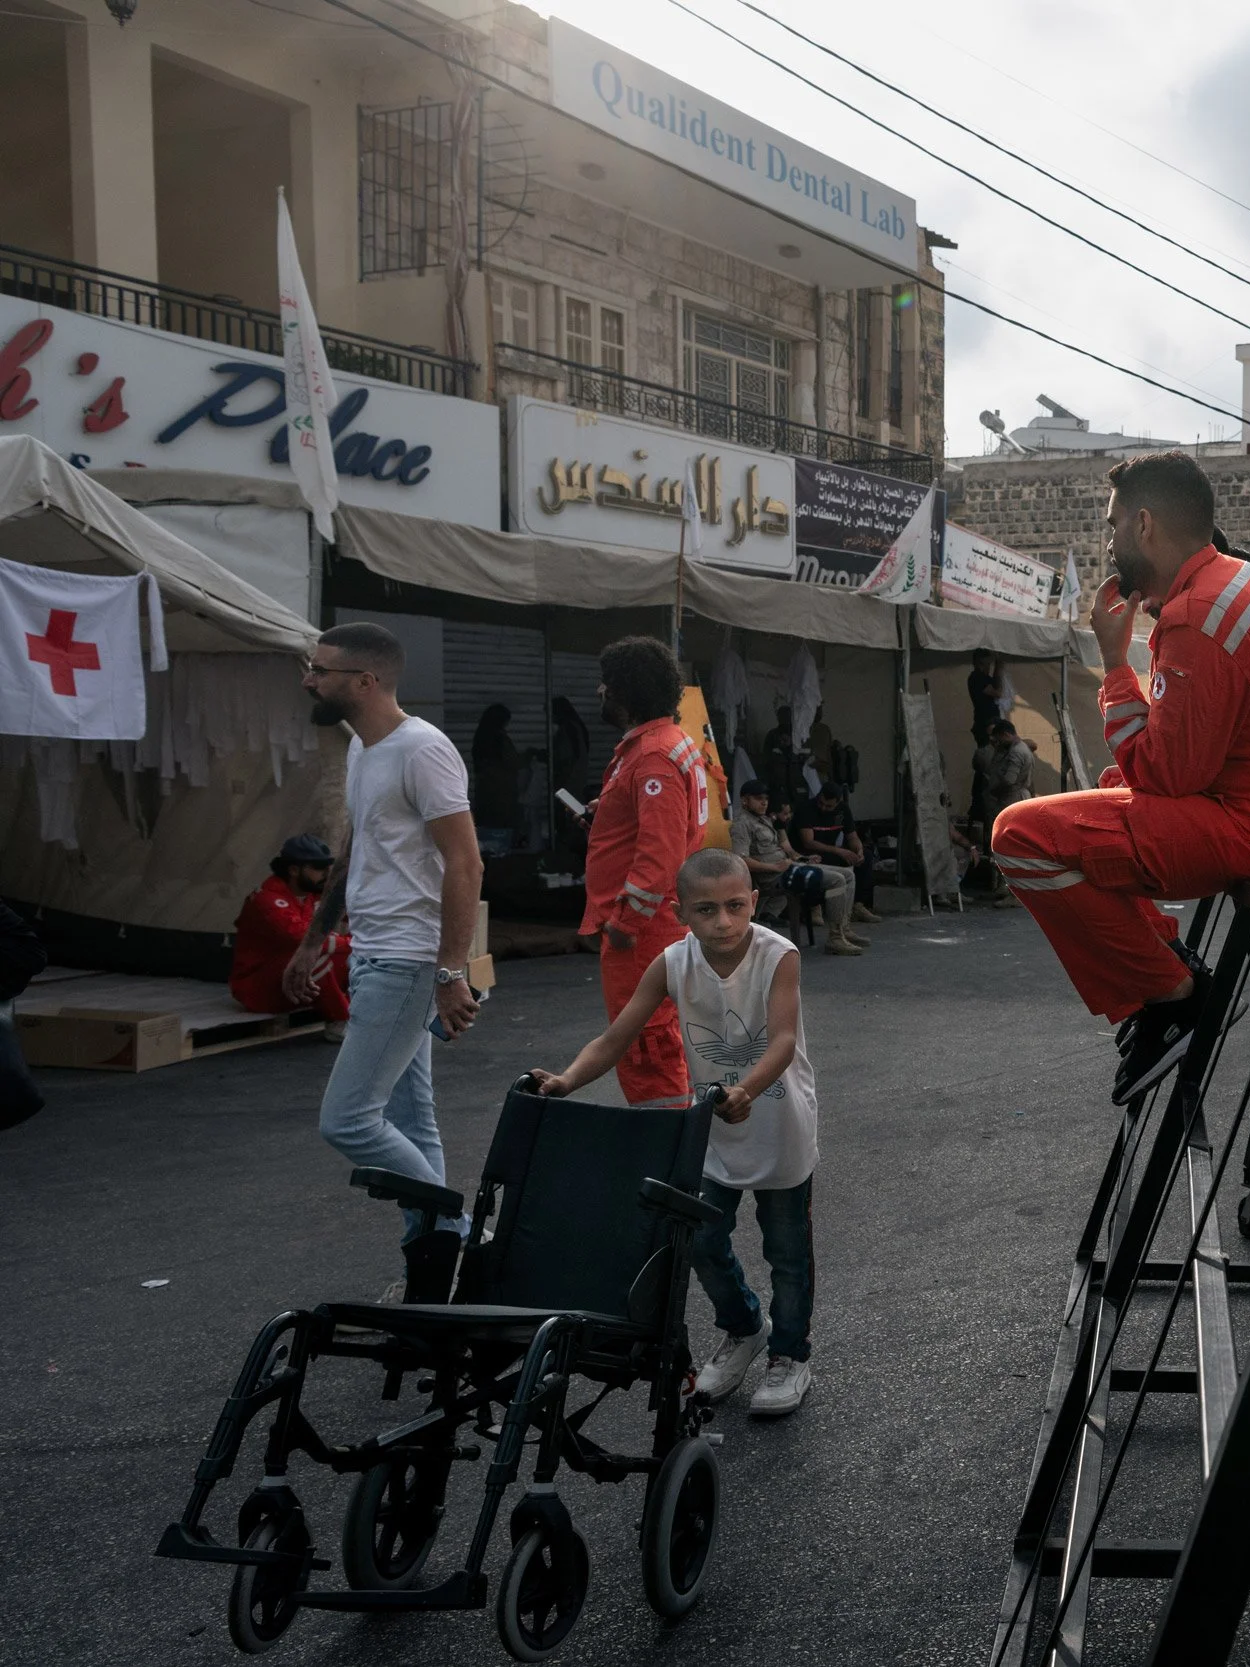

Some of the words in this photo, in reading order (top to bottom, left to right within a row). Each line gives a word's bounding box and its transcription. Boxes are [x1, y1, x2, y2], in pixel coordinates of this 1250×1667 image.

[592, 60, 757, 172] Qualident
[765, 141, 852, 216] Dental
[859, 188, 906, 241] Lab
[725, 465, 790, 548] دار
[883, 485, 904, 499] الحسين
